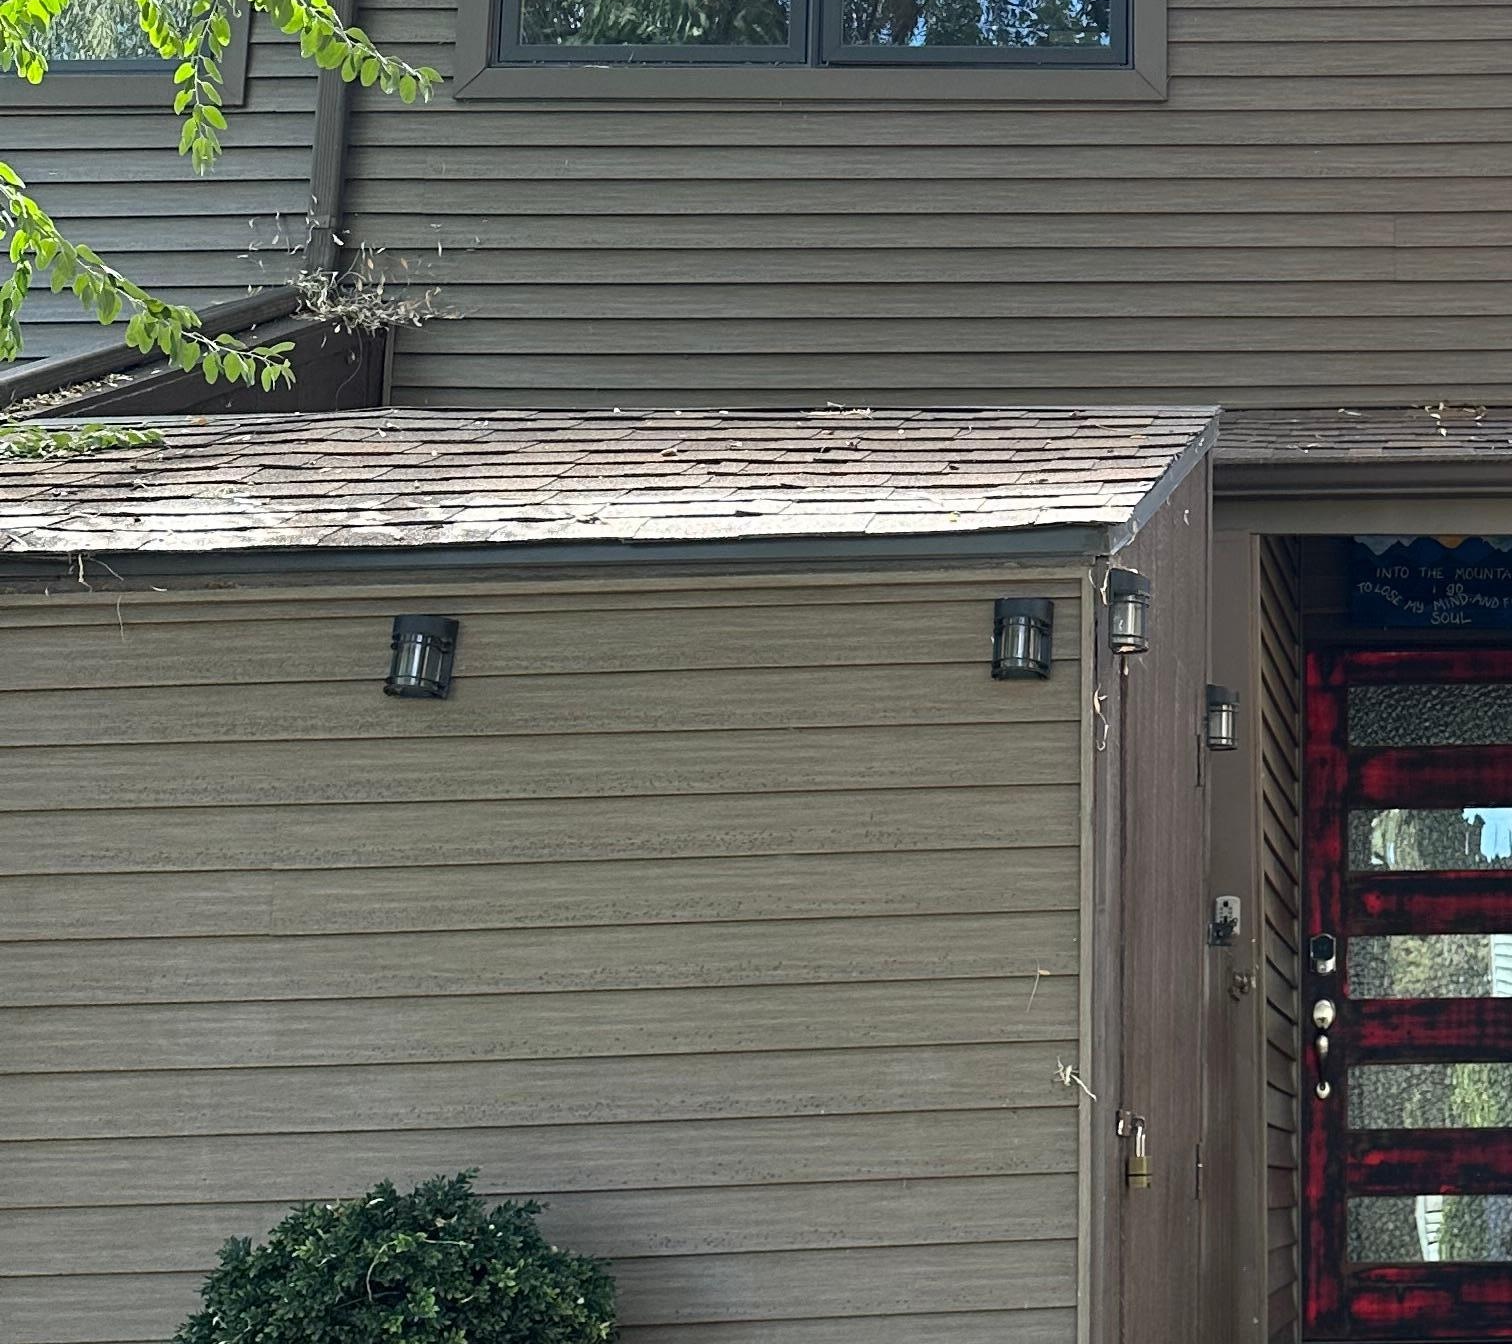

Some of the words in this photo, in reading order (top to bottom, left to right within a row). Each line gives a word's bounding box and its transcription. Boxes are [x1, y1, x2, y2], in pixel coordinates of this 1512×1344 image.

[1375, 566, 1410, 579] INTO
[1418, 567, 1444, 579] THE
[1358, 582, 1372, 593] TO
[1374, 585, 1403, 606] LOSE
[1403, 600, 1425, 614] MY
[1430, 611, 1473, 625] SOUL
